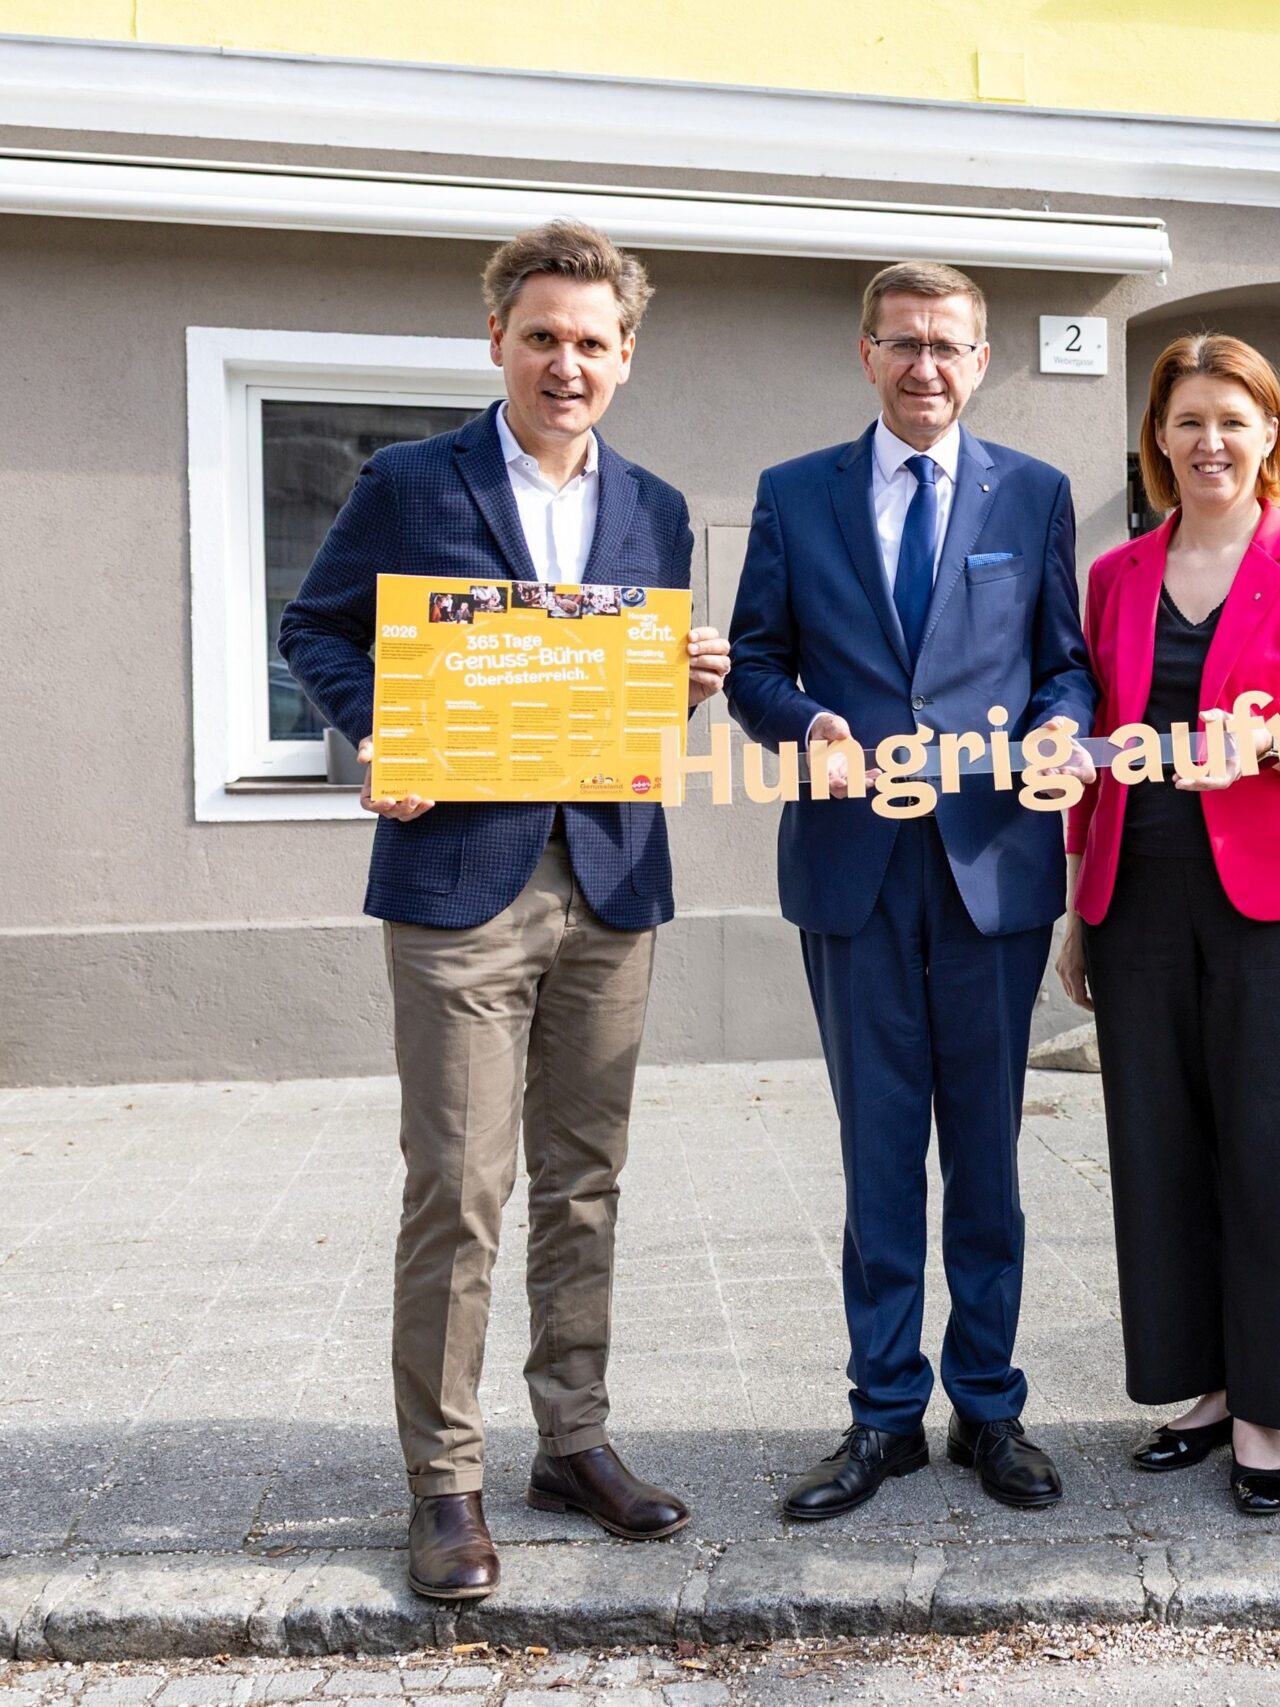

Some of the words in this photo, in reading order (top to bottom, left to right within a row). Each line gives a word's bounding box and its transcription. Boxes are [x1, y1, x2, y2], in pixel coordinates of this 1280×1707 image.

[1065, 324, 1082, 352] 2
[381, 625, 417, 639] 2026
[466, 634, 500, 651] 365
[502, 633, 543, 651] Tage
[445, 647, 606, 671] Genuss-Bühne
[464, 667, 590, 687] Oberösterreich.
[660, 705, 1084, 819] Hungrig
[1108, 690, 1274, 785] auf
